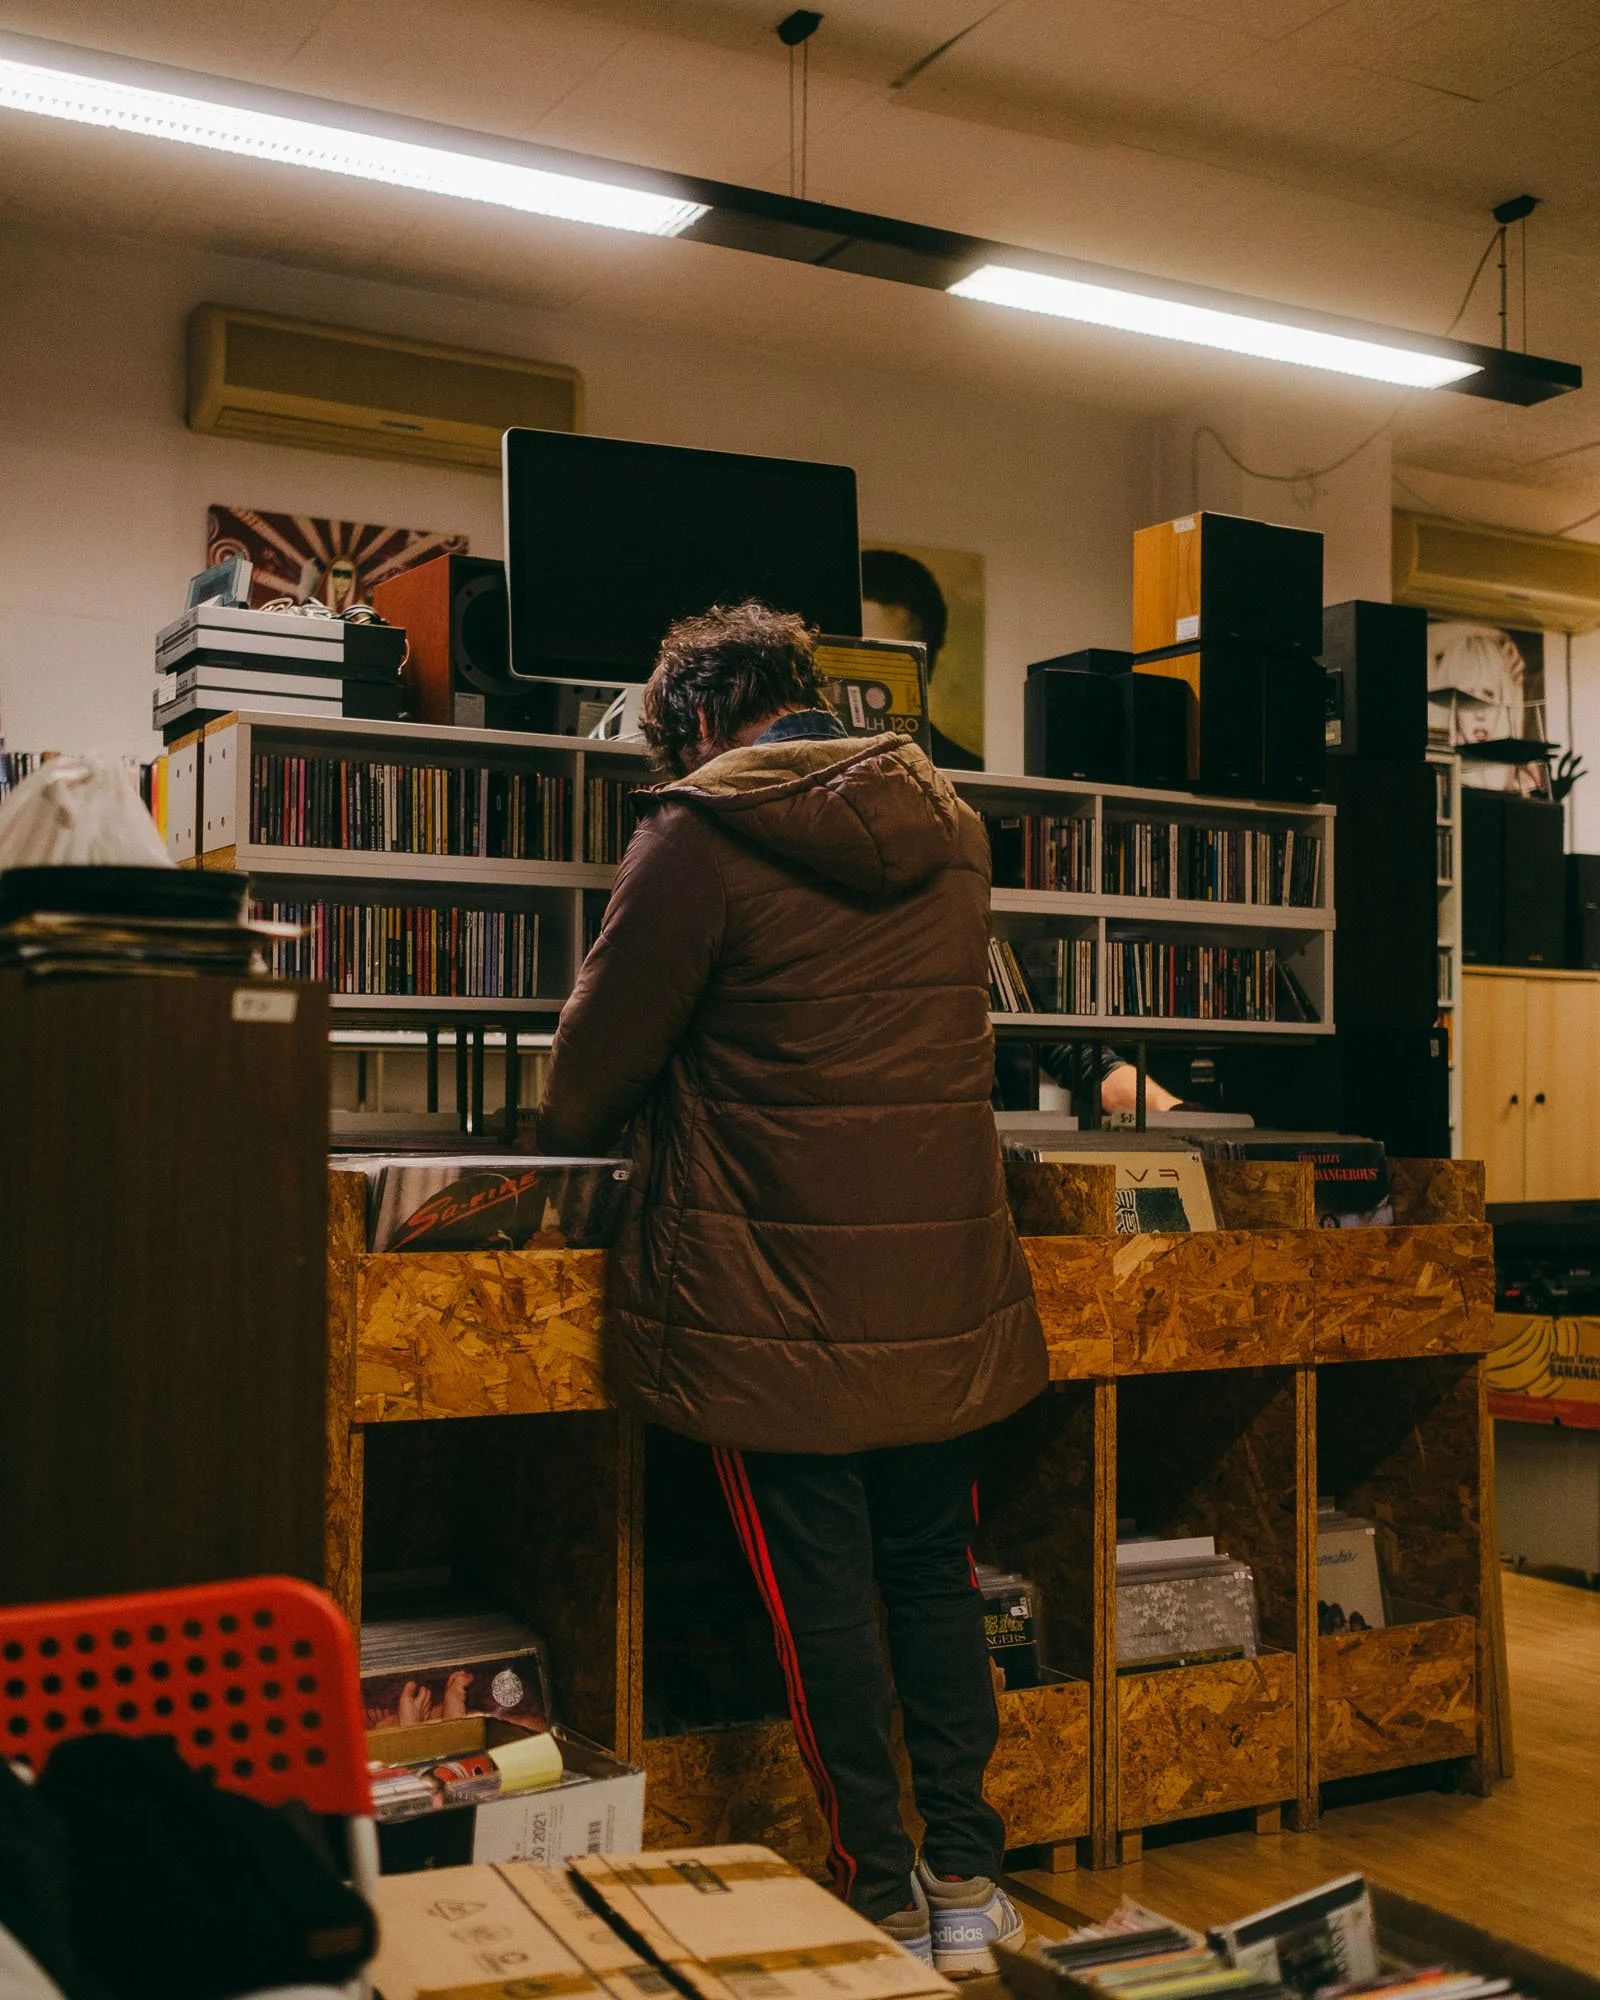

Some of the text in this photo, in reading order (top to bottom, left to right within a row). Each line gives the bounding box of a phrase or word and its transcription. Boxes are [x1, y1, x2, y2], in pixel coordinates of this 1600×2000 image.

[866, 716, 919, 733] LH 120
[985, 1633, 1027, 1645] NGERS
[532, 1812, 547, 1844] 2021
